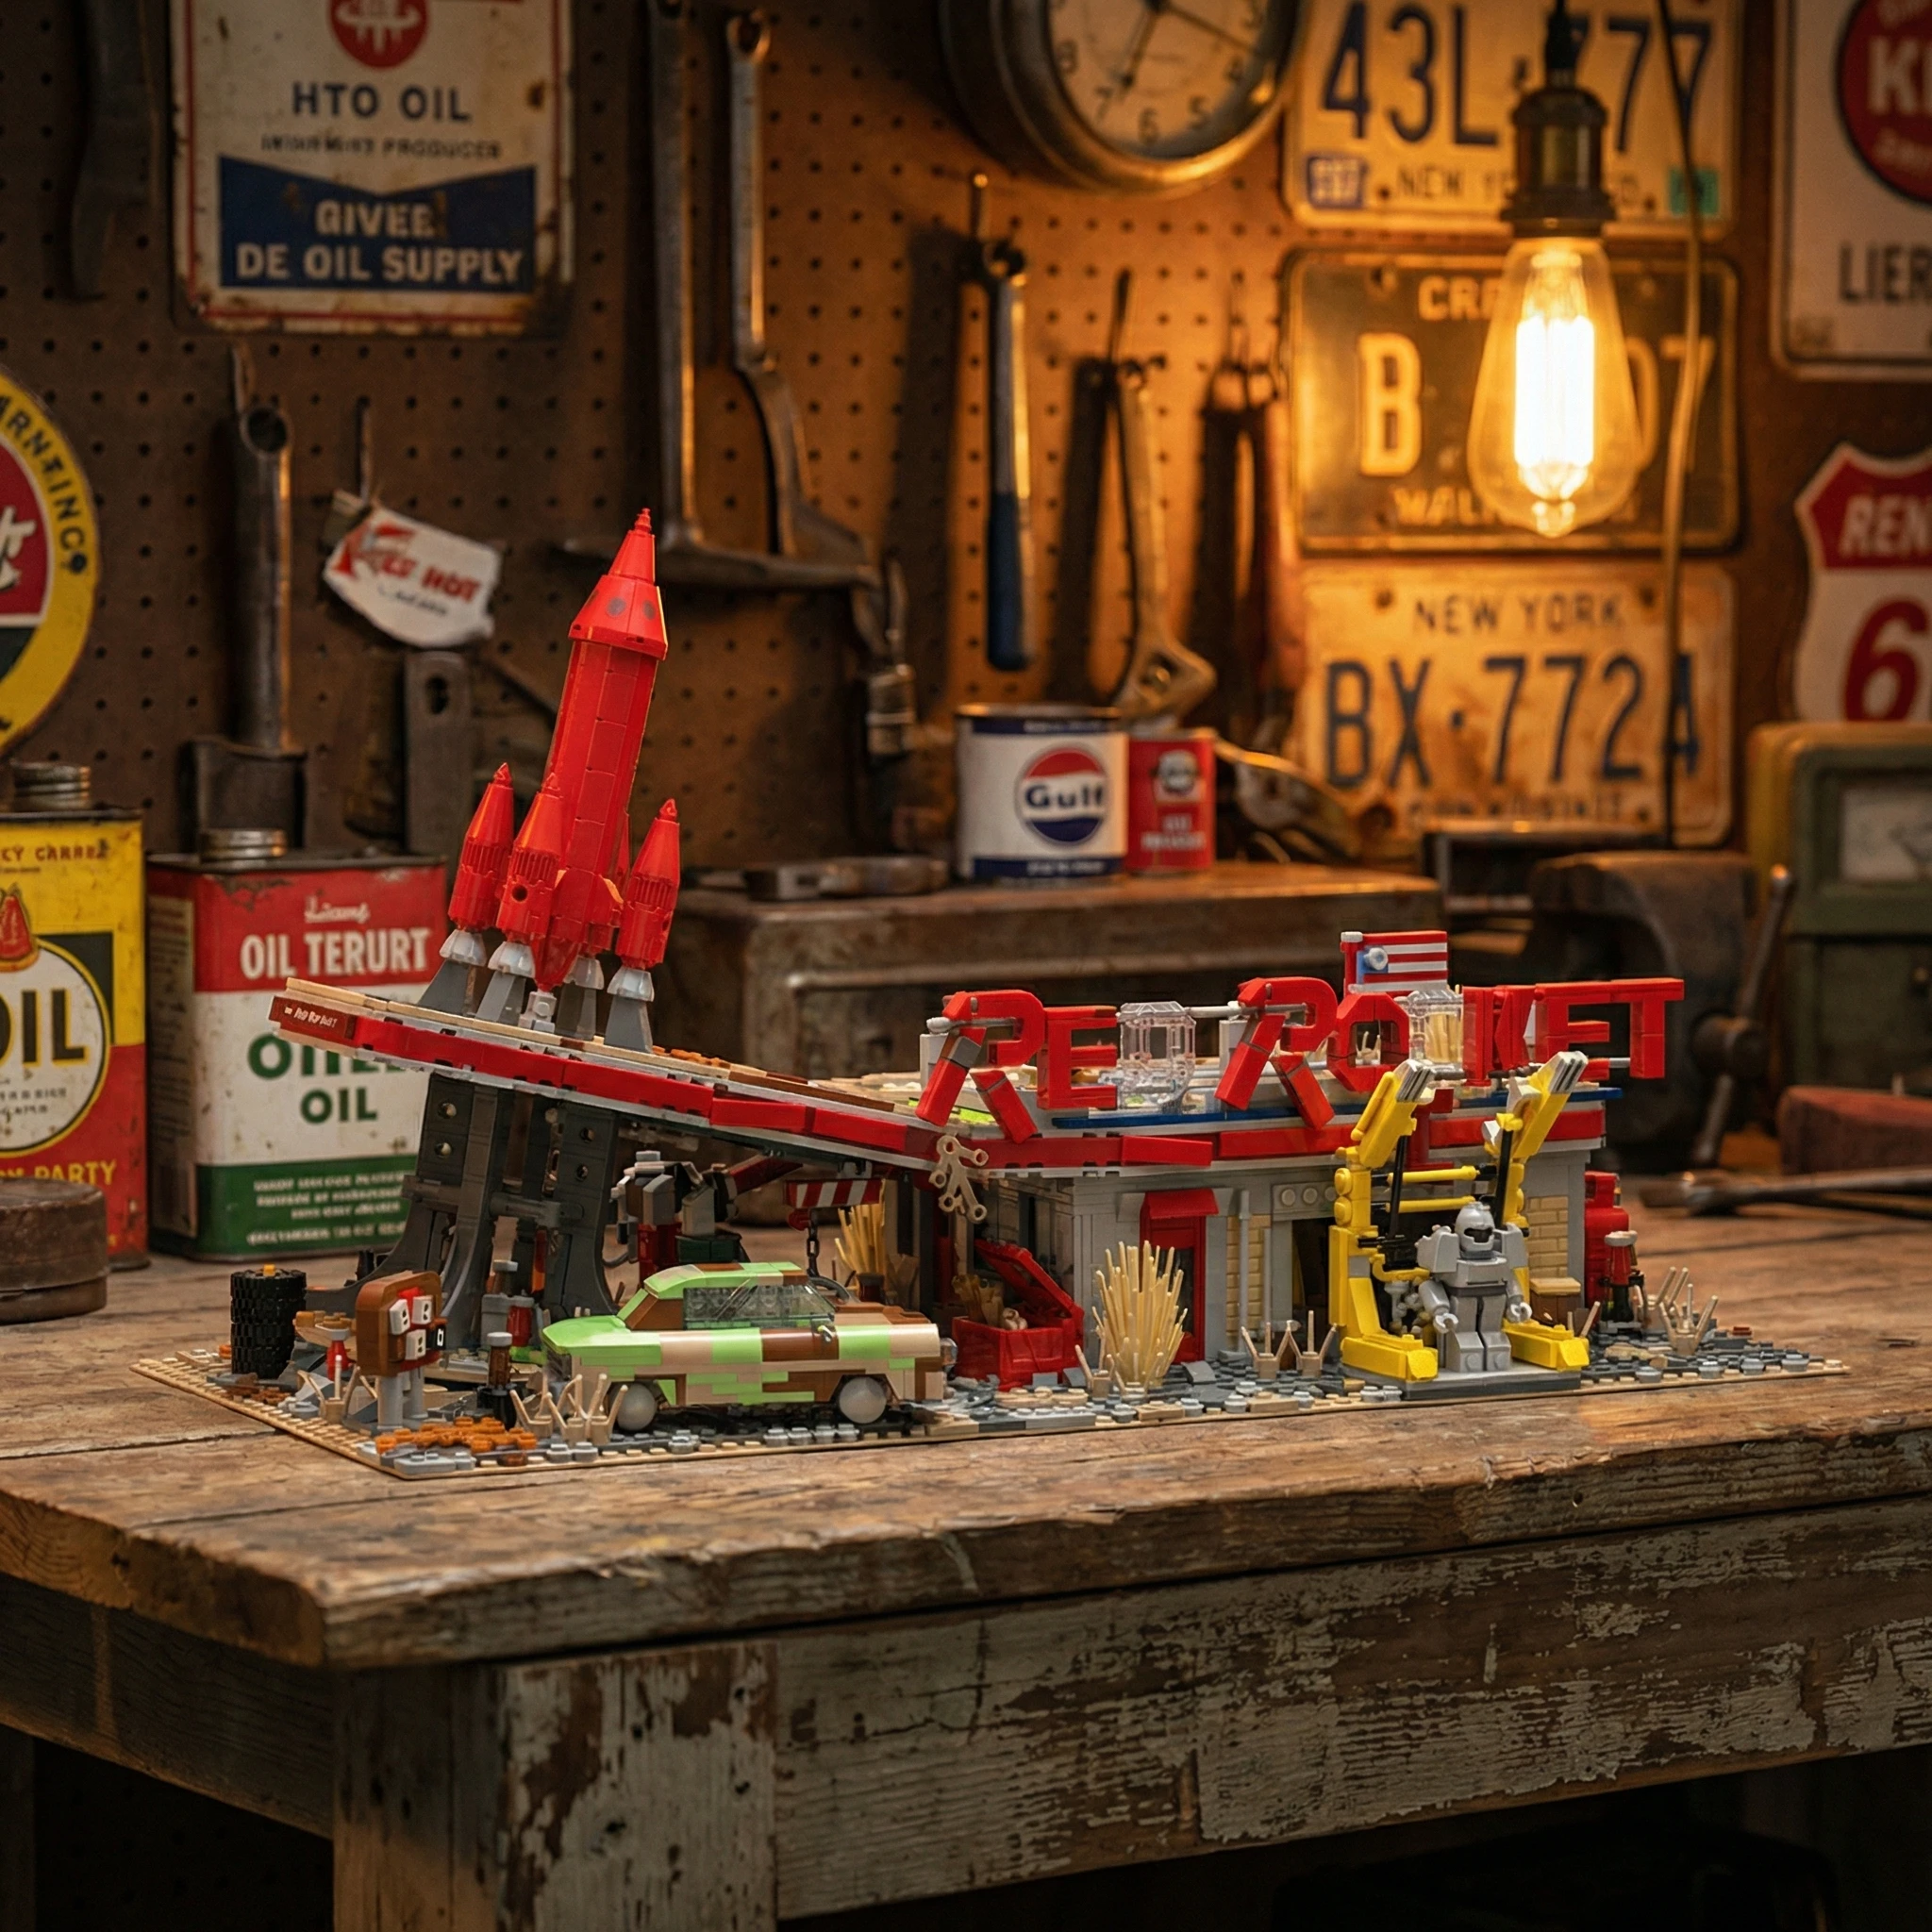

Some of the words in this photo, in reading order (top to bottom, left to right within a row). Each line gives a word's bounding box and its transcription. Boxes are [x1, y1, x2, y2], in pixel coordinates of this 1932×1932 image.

[292, 82, 378, 118] HTO
[397, 86, 471, 122] OIL
[236, 243, 291, 278] DE
[303, 245, 371, 281] OIL
[381, 248, 524, 283] SUPPLY
[1357, 332, 1422, 477] B
[1415, 593, 1499, 635] NEW
[1518, 591, 1624, 633] YORK
[240, 935, 295, 978] OIL
[304, 927, 430, 975] TERURT
[300, 1088, 377, 1124] OIL
